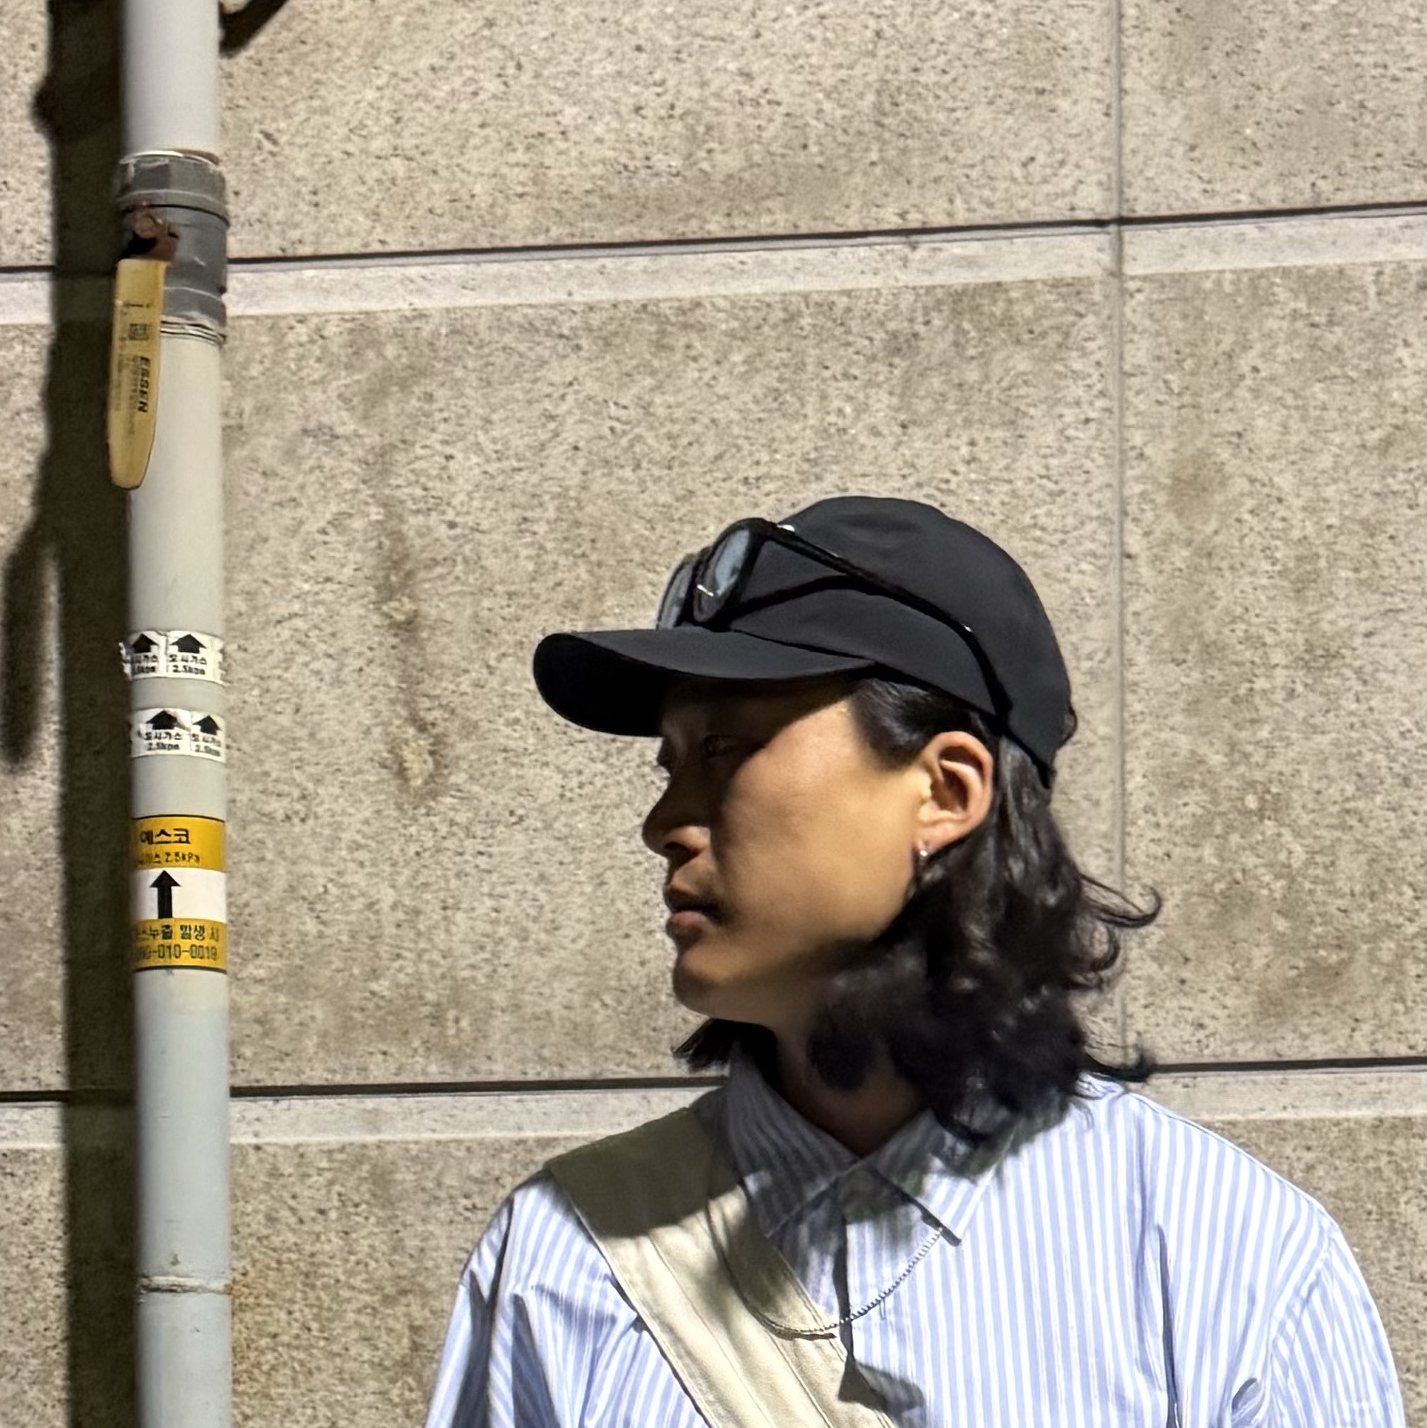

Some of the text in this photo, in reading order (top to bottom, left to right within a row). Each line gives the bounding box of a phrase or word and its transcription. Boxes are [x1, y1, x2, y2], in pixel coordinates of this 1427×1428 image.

[137, 355, 151, 413] ESSEN
[169, 654, 207, 665] 도시가스
[145, 731, 182, 741] 도시가스
[140, 828, 191, 845] 예스코
[137, 925, 173, 940] 스누출
[180, 924, 205, 941] 발생
